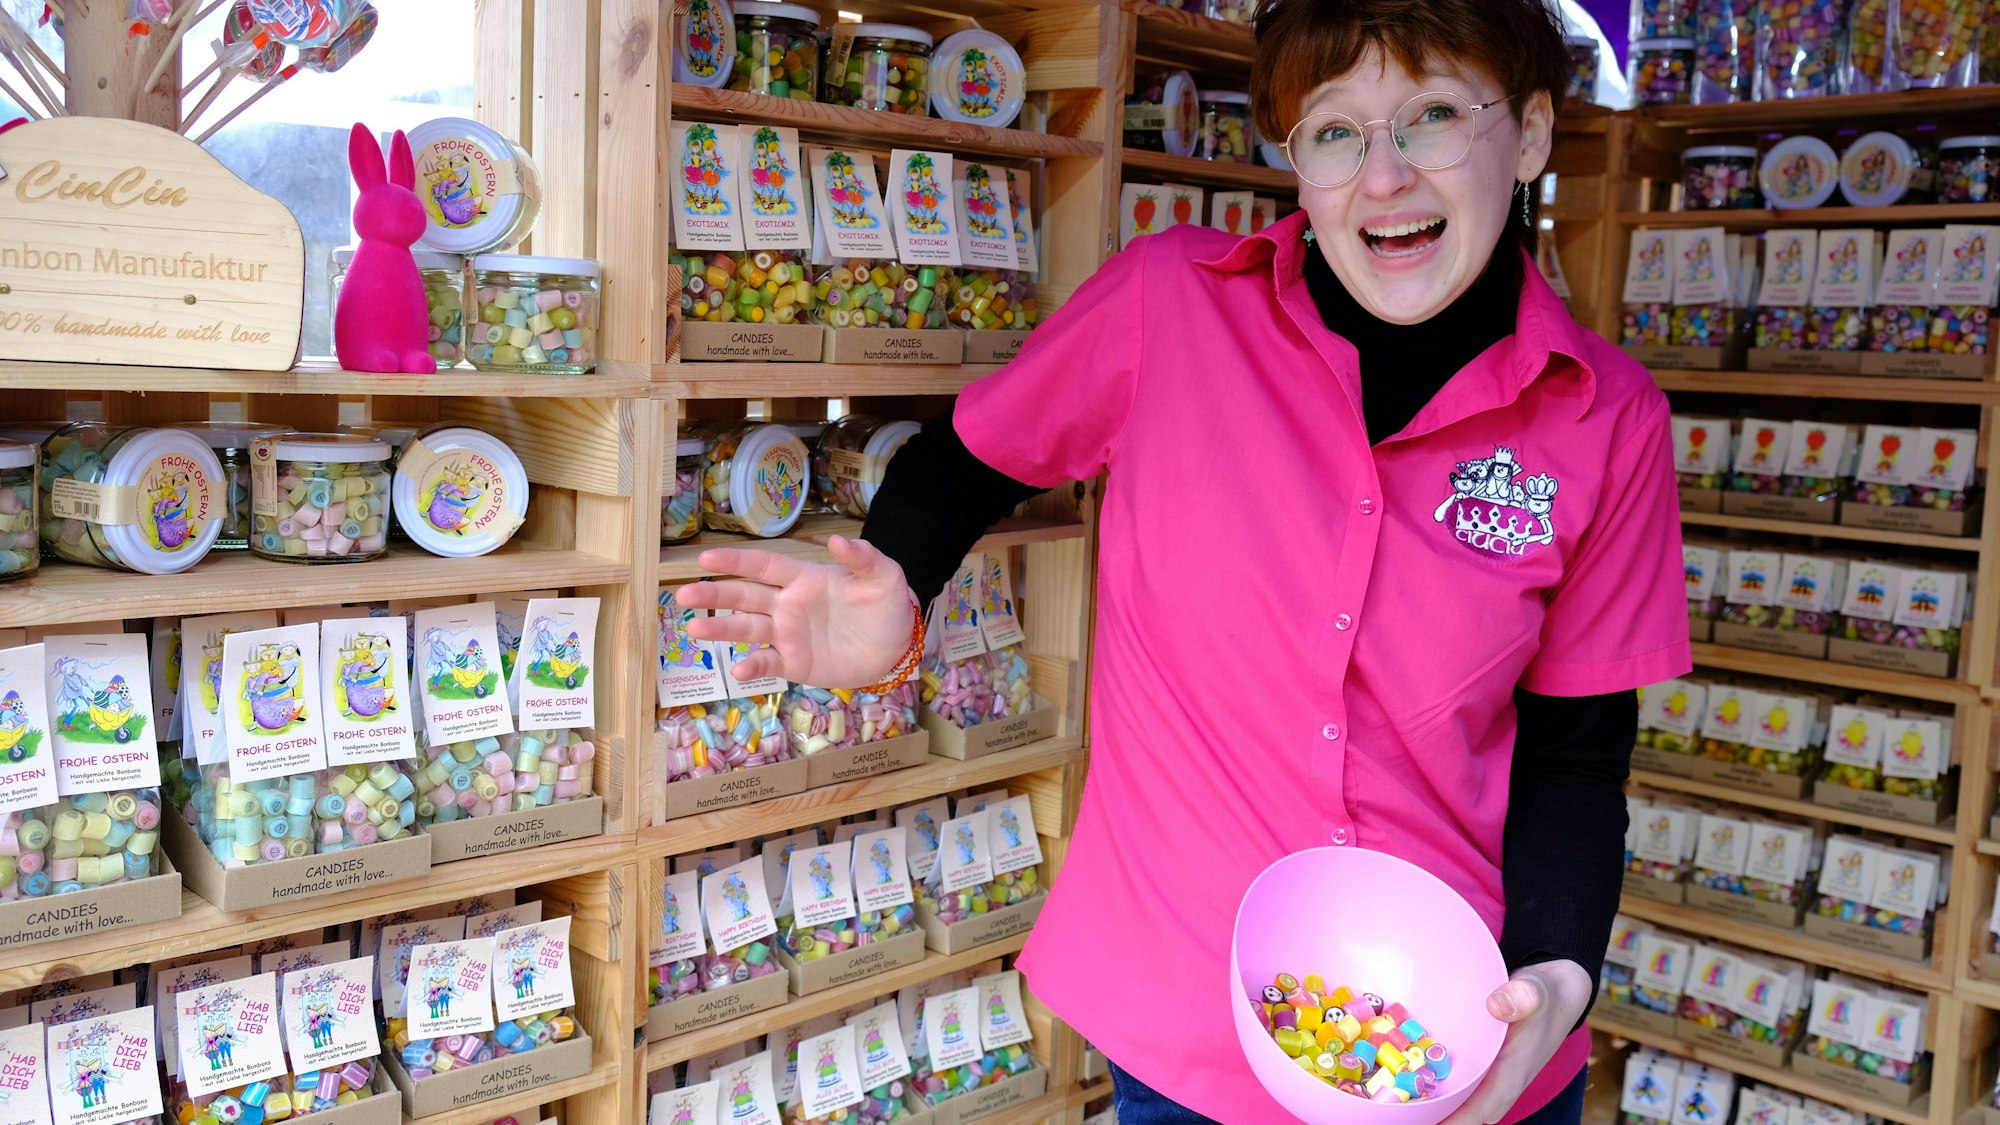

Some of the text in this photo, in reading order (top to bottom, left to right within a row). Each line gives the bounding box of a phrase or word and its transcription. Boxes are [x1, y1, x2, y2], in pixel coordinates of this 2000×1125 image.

[433, 140, 496, 197] FROHE OSTERN
[15, 160, 189, 210] CinCin
[687, 220, 729, 229] EXOTICMIX
[909, 238, 948, 246] EXOTICMIX
[94, 248, 268, 282] Manufaktur
[54, 313, 167, 339] handmade
[176, 320, 222, 342] with
[230, 324, 271, 344] love
[731, 333, 774, 343] CANDIES
[884, 339, 922, 348] CANDIES
[707, 345, 750, 355] handmade
[753, 346, 770, 355] with
[864, 350, 902, 359] handmade
[903, 350, 919, 359] with
[161, 456, 209, 521] FROHE OSTERN
[470, 454, 503, 529] FROHE OSTERN
[526, 697, 588, 708] FROHE OSTERN
[433, 704, 503, 723] FROHE OSTERN
[334, 726, 406, 741] FROHE OSTERN
[236, 737, 317, 758] FROHE OSTERN
[60, 752, 149, 768] FROHE OSTERN
[853, 750, 888, 764] CANDIES
[720, 777, 761, 792] CANDIES
[697, 793, 738, 808] handmade
[741, 789, 757, 800] with
[494, 819, 544, 836] CANDIES
[465, 837, 517, 854] handmade
[520, 832, 540, 844] with
[305, 859, 364, 878] CANDIES
[272, 879, 332, 898] handmade
[336, 874, 360, 887] with
[27, 903, 98, 925] CANDIES
[64, 920, 93, 934] with
[545, 937, 564, 950] HAB
[540, 949, 564, 960] DICH
[849, 951, 885, 968] CANDIES
[467, 959, 487, 972] HAB
[538, 957, 559, 969] LIEB
[460, 968, 486, 983] DICH
[346, 981, 366, 994] HAB
[456, 978, 479, 992] LIEB
[339, 992, 365, 1004] DICH
[698, 995, 740, 1013] CANDIES
[246, 1000, 270, 1012] HAB
[337, 1002, 360, 1015] LIEB
[240, 1010, 269, 1024] DICH
[674, 1012, 717, 1031] handmade
[719, 1006, 737, 1018] with
[237, 1022, 263, 1034] LIEB
[123, 1034, 148, 1048] HAB
[10, 1053, 36, 1066] HAB
[116, 1046, 148, 1060] DICH
[2, 1064, 36, 1079] DICH
[112, 1057, 141, 1071] LIEB
[200, 1061, 271, 1082] Handgemachte Bonbons
[481, 1064, 532, 1085] CANDIES
[0, 1076, 29, 1090] LIEB
[453, 1084, 504, 1104] handmade
[507, 1078, 528, 1091] with
[70, 1098, 148, 1120] Handgemachte Bonbons
